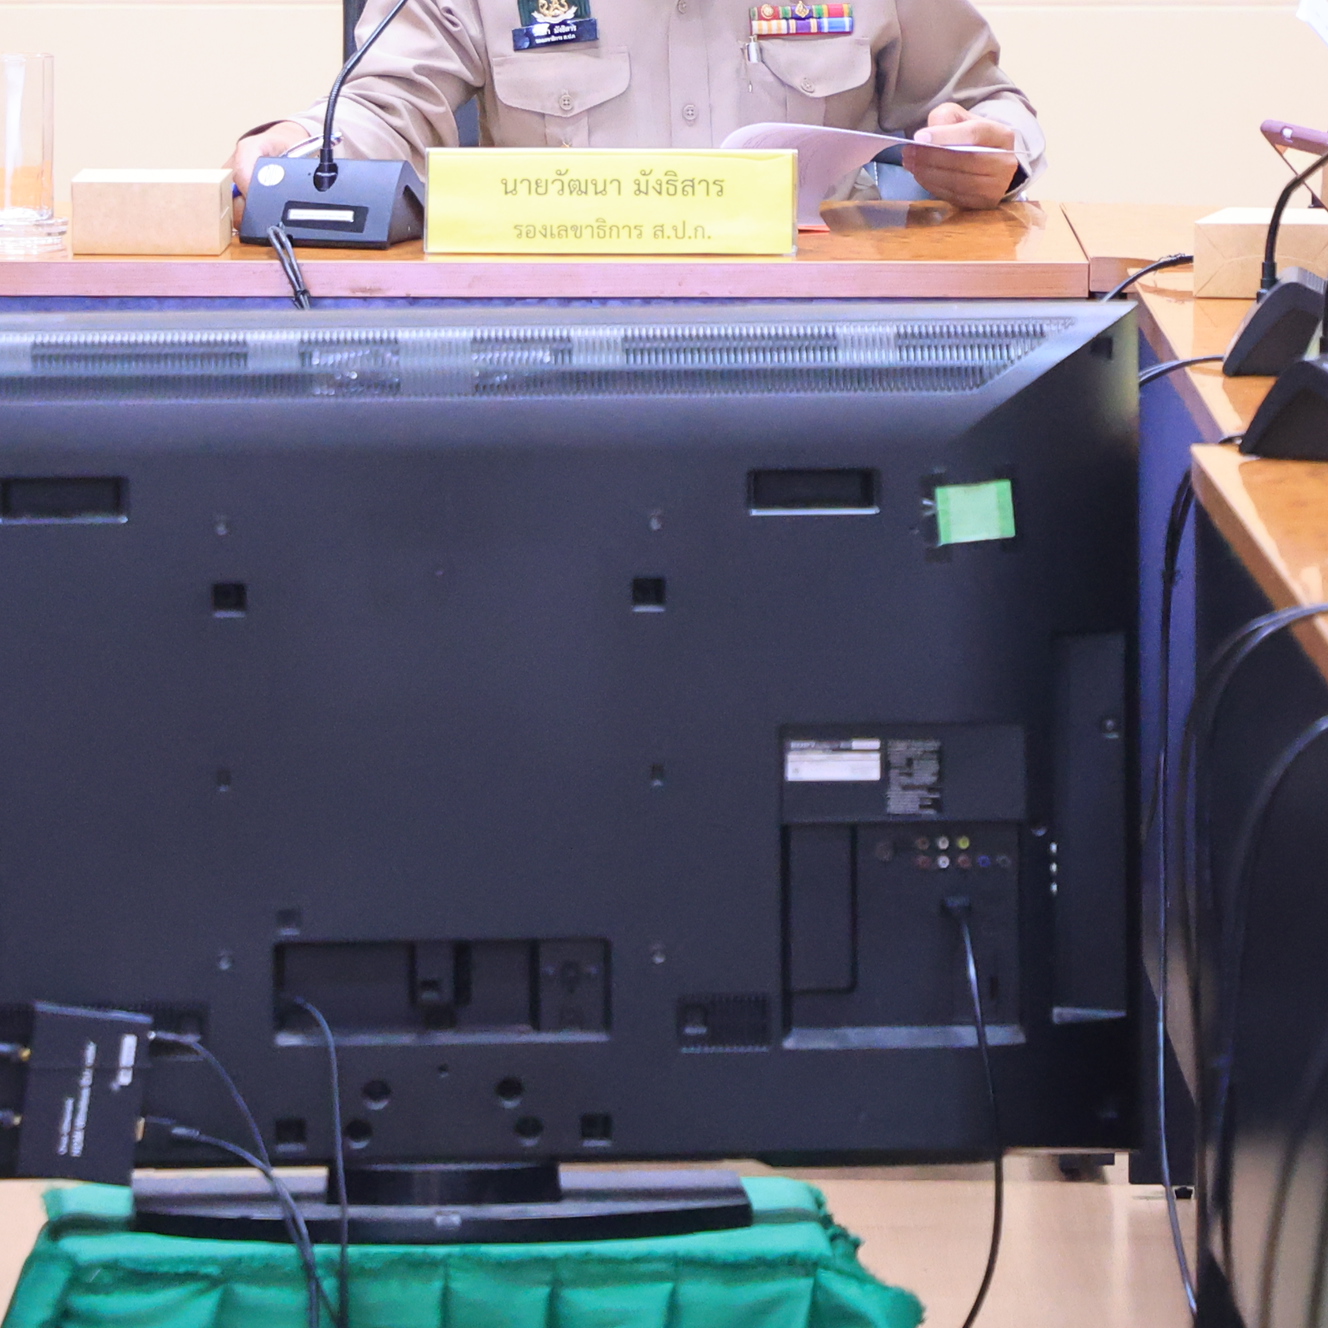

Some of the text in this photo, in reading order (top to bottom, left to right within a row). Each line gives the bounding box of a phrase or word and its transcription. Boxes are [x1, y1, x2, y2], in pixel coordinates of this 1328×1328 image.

[500, 168, 725, 197] นายวัฒนา มังธิสาร
[513, 217, 712, 239] รองเลขาธิการ ส.ป.ก.
